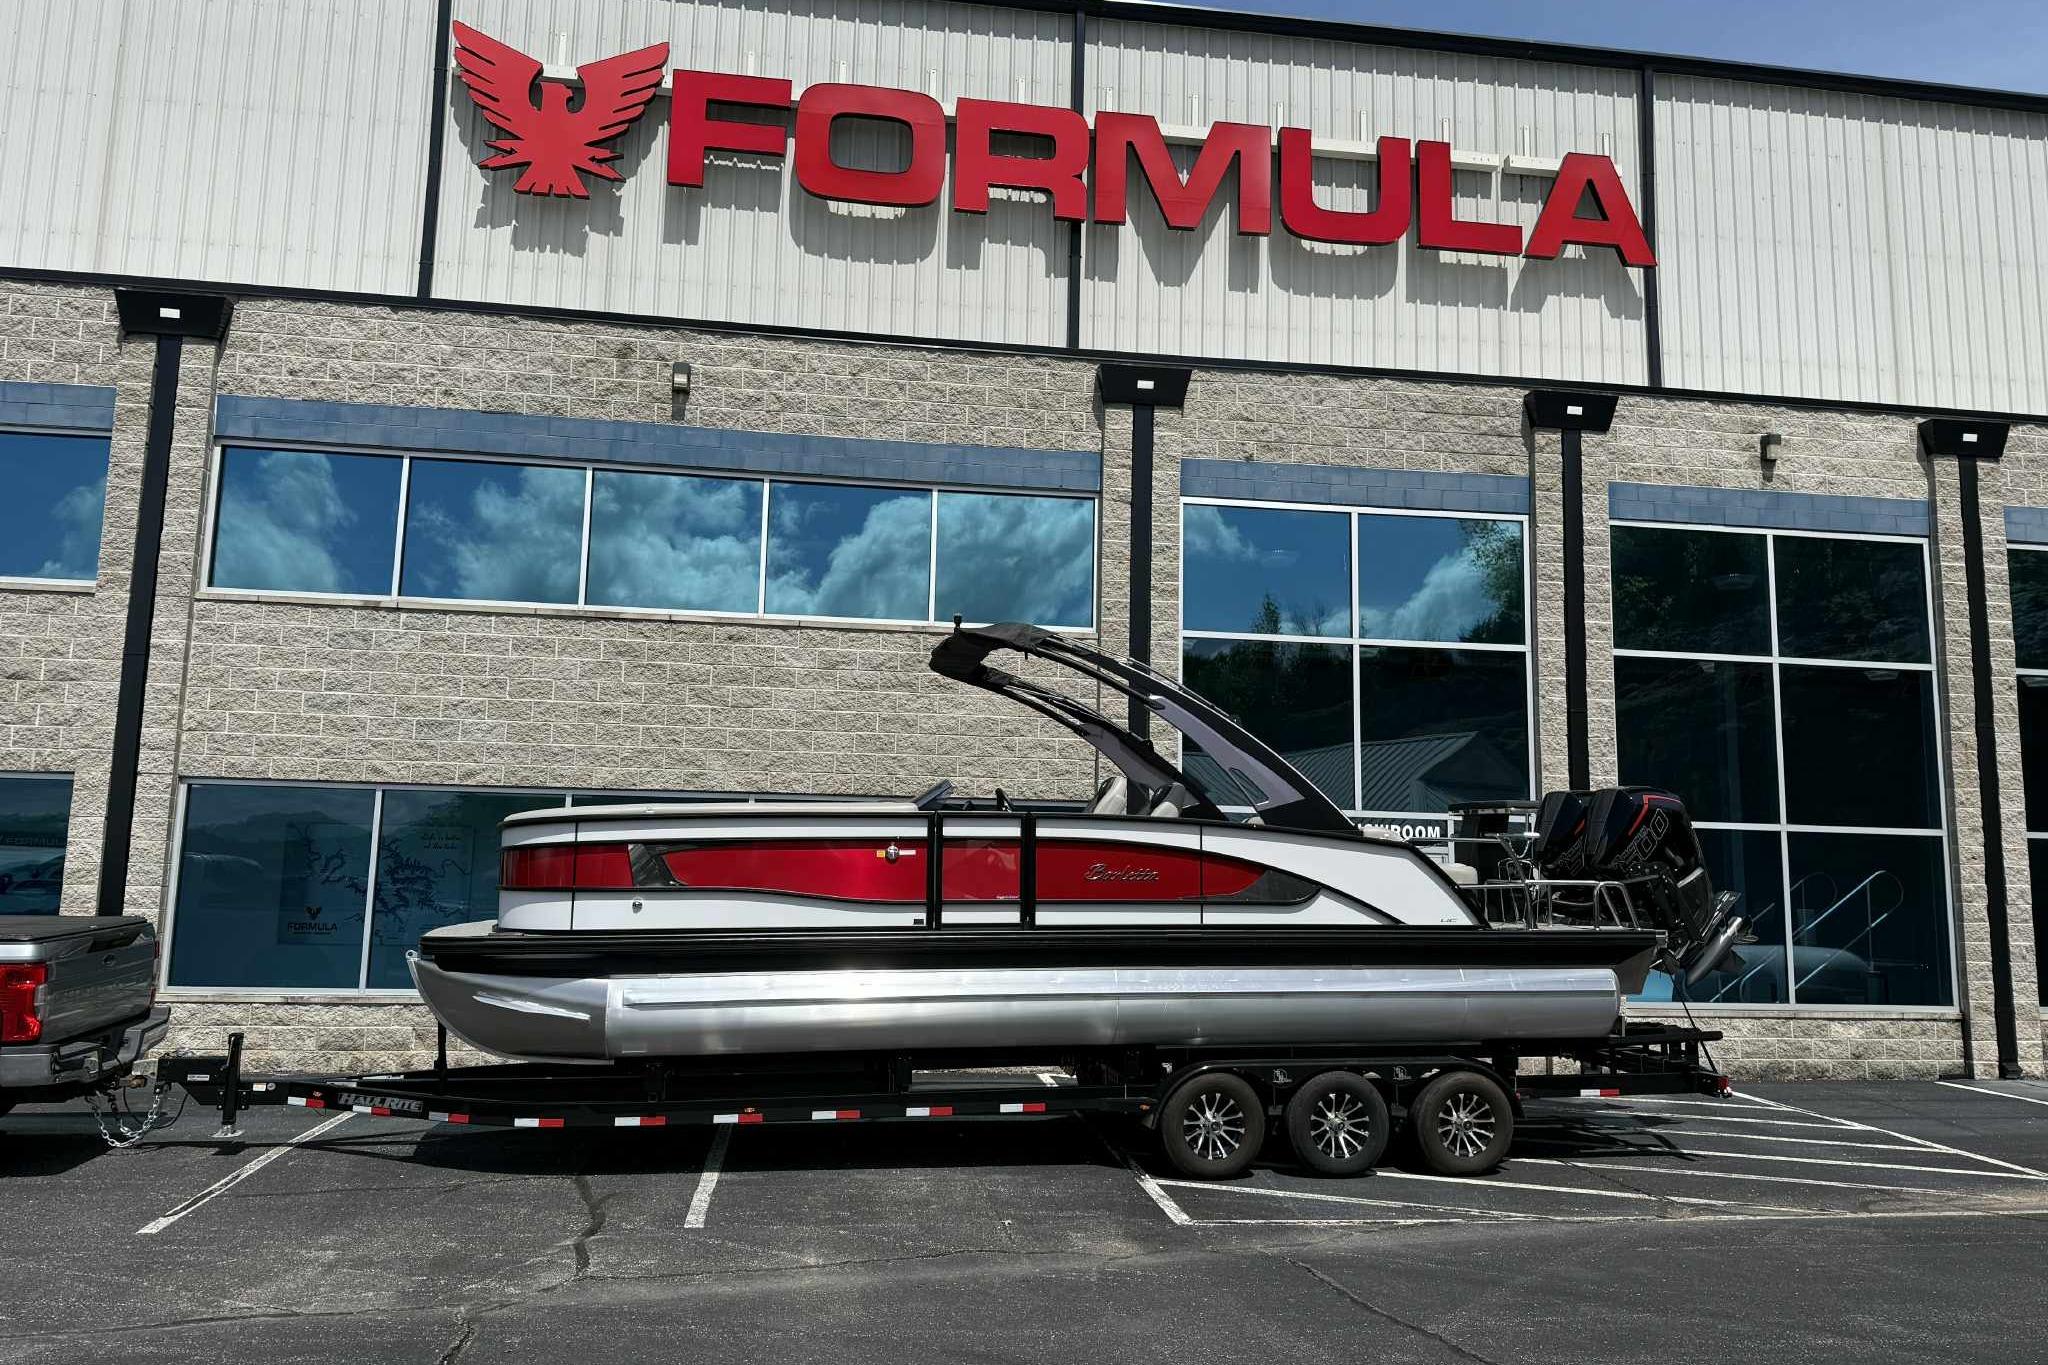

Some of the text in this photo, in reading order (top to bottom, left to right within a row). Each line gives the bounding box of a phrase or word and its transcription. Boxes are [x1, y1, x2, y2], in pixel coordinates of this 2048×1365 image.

[667, 69, 1657, 268] FORMULA
[1357, 823, 1440, 839] ROOM
[287, 922, 337, 932] FORMULA
